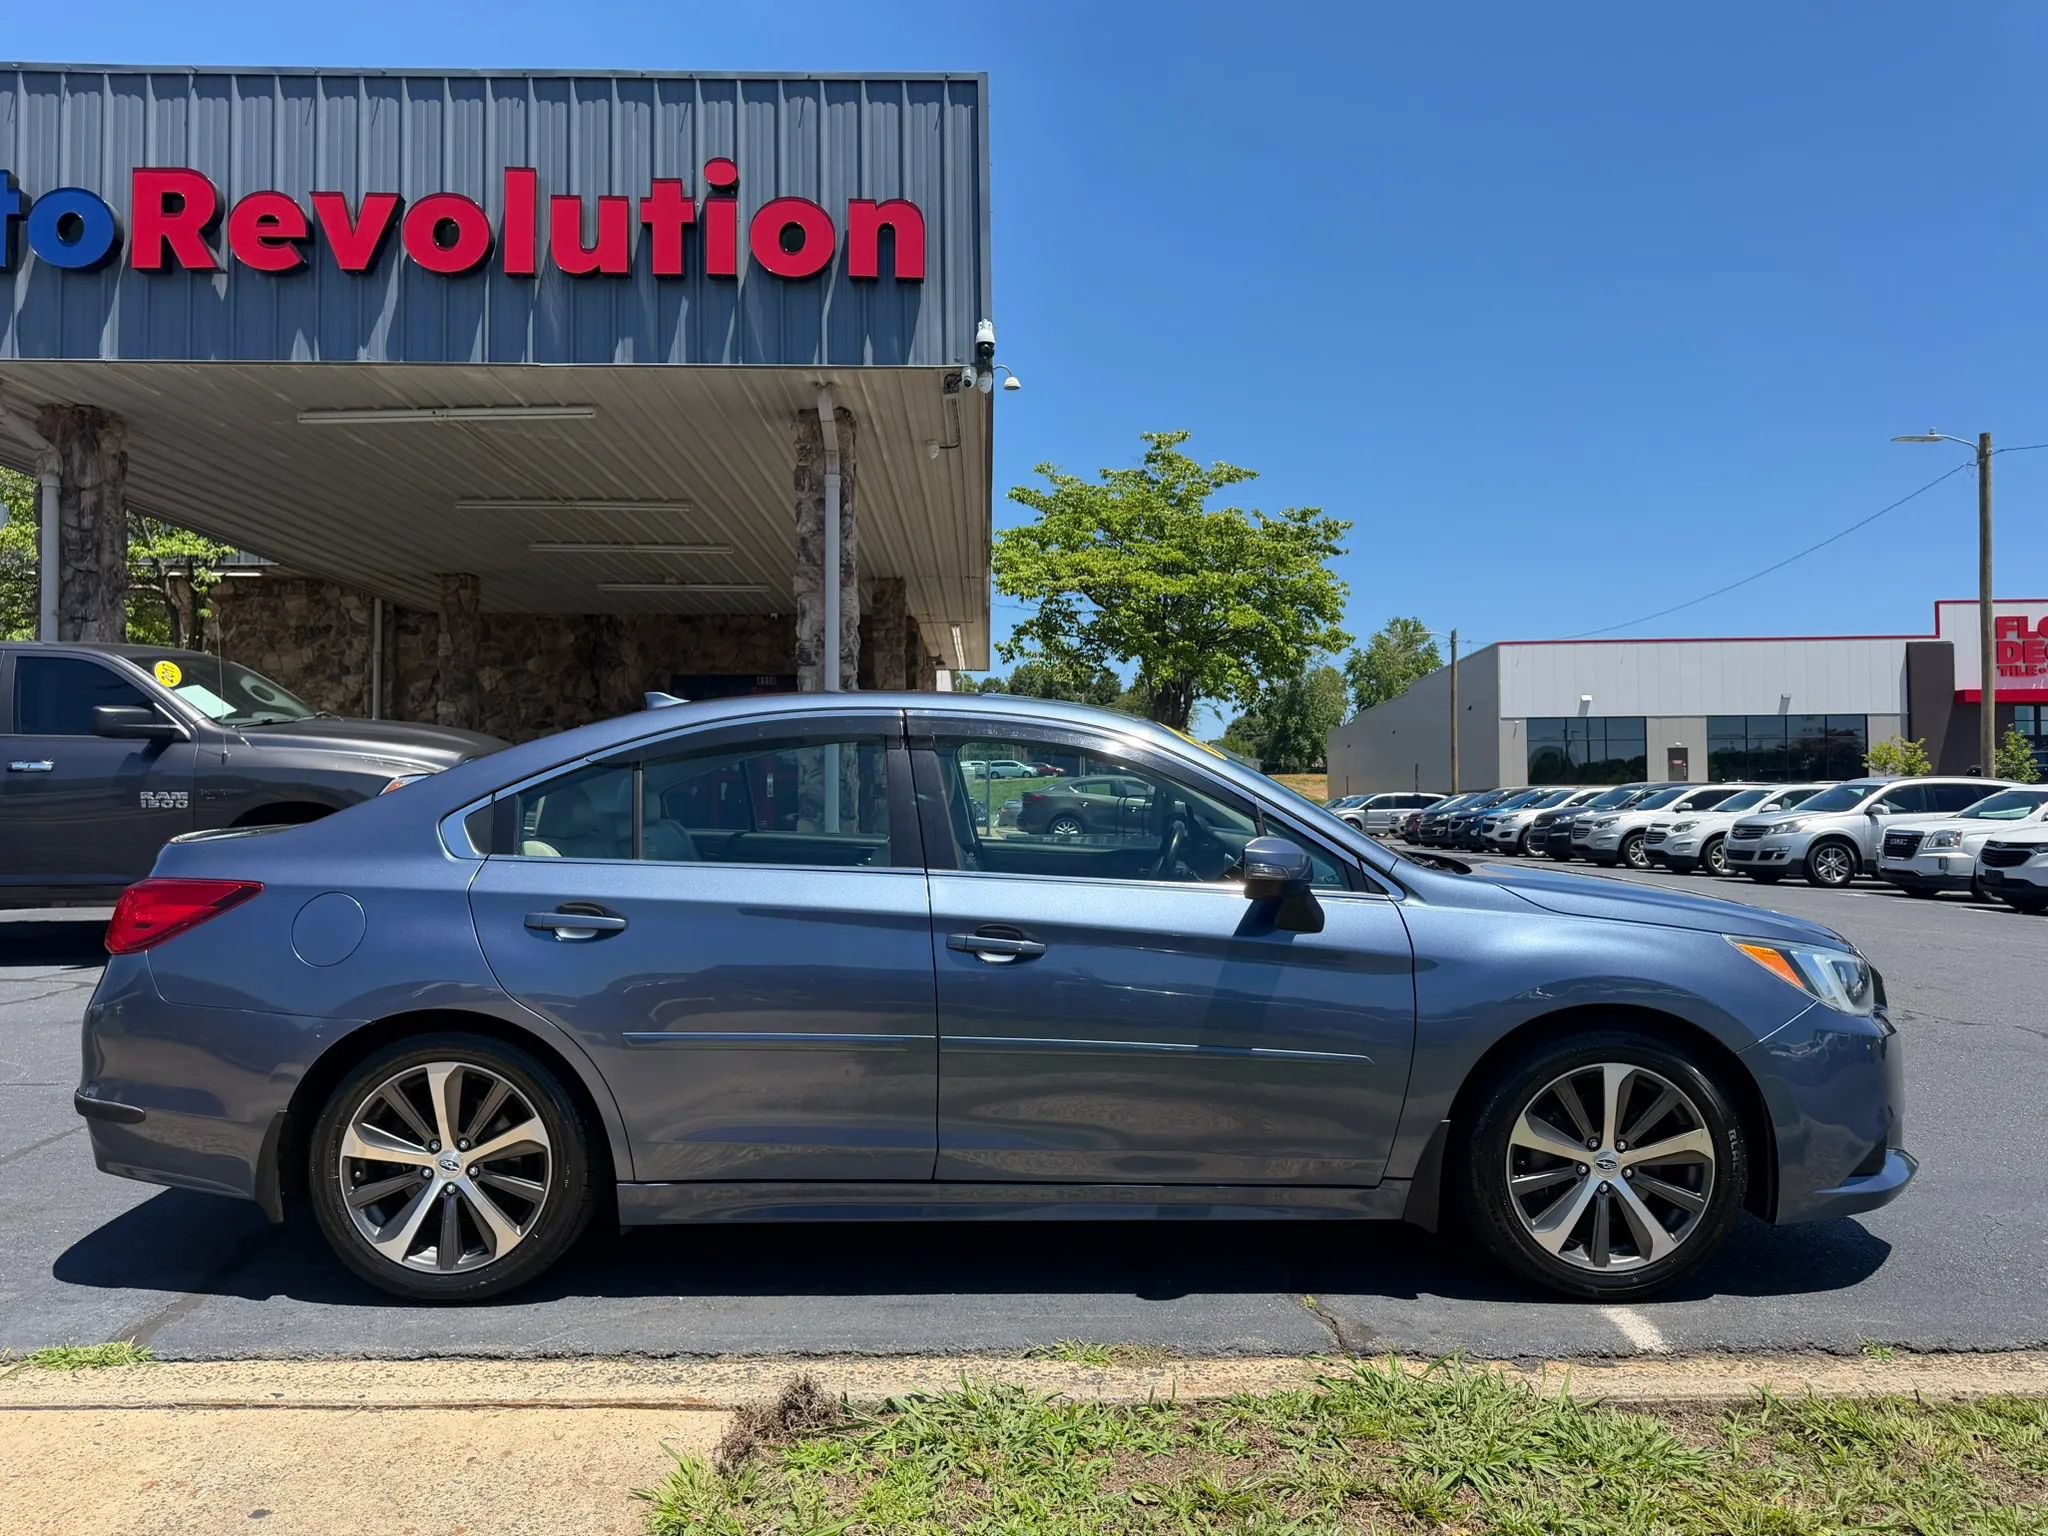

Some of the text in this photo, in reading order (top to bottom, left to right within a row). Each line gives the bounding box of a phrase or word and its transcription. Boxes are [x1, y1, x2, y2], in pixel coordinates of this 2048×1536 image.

[1996, 641, 2048, 665] DE
[140, 791, 189, 800] RAM
[140, 799, 189, 809] 1500
